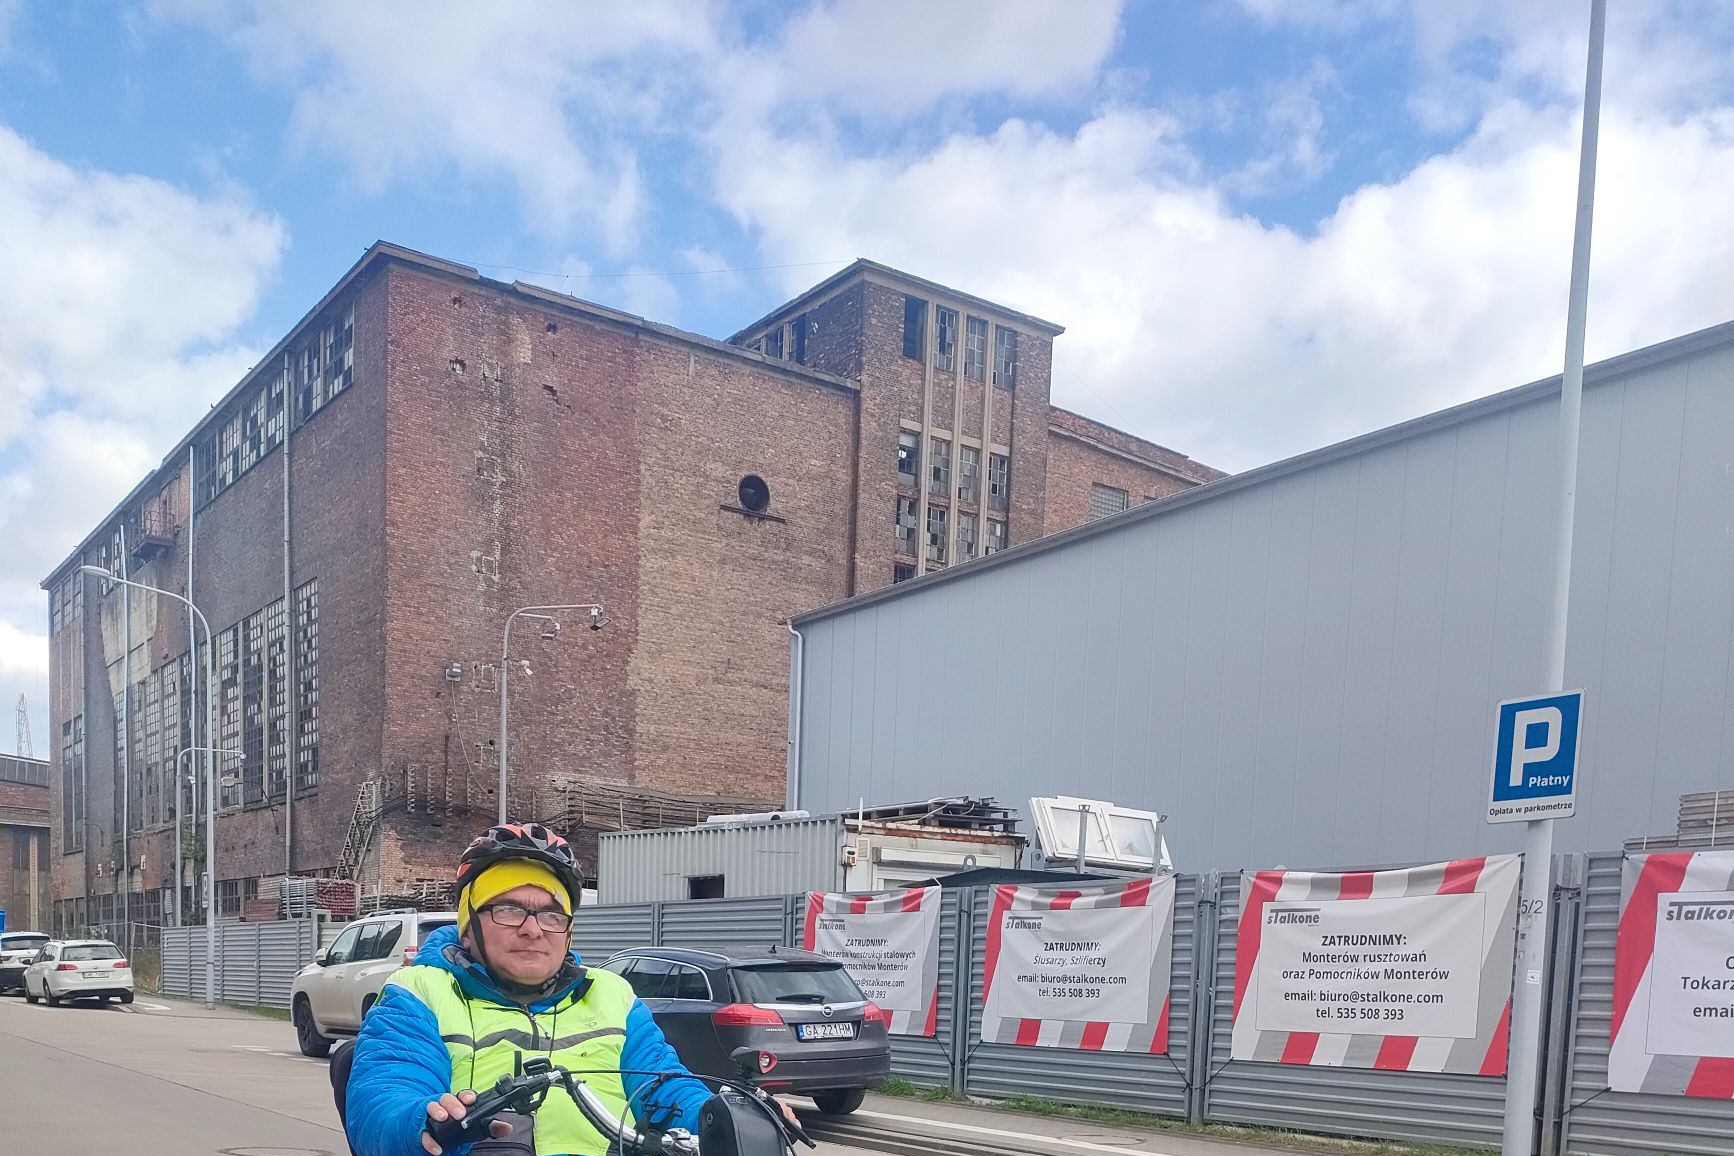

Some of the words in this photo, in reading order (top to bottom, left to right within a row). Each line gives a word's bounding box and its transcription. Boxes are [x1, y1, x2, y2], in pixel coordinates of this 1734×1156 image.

[1509, 706, 1563, 787] P
[1528, 775, 1570, 788] Płatny
[1489, 806, 1513, 817] Opłata
[1524, 801, 1573, 814] parkometrze
[845, 938, 889, 947] ZATRUDNIMY:
[1321, 934, 1408, 946] ZATRUDNIMY:
[1043, 942, 1101, 952] ZATRUDNIMY:
[883, 950, 917, 961] stalowych
[1033, 953, 1068, 967] Ślusarzy,
[1070, 955, 1107, 968] Szlifierzy
[1302, 951, 1360, 963] Monterów
[1363, 950, 1427, 963] rusztowań
[842, 962, 876, 971] omocników
[877, 962, 909, 971] Monterów
[1017, 973, 1039, 983] email:
[1040, 973, 1127, 985] biuro@stalkone.com
[1282, 969, 1305, 979] oraz
[1308, 968, 1380, 980] Pomocników
[1383, 967, 1450, 980] Monterów
[875, 991, 887, 999] 393
[1038, 987, 1051, 997] tel.
[1052, 988, 1066, 998] 535
[1068, 988, 1083, 998] 508
[1085, 988, 1101, 999] 393
[1284, 989, 1317, 1001] email:
[1319, 989, 1444, 1004] biuro@stalkone.com
[1316, 1006, 1334, 1018] tel.
[1336, 1007, 1357, 1019] 535
[1359, 1007, 1380, 1020] 508
[1382, 1008, 1405, 1021] 393
[805, 1025, 819, 1036] GA
